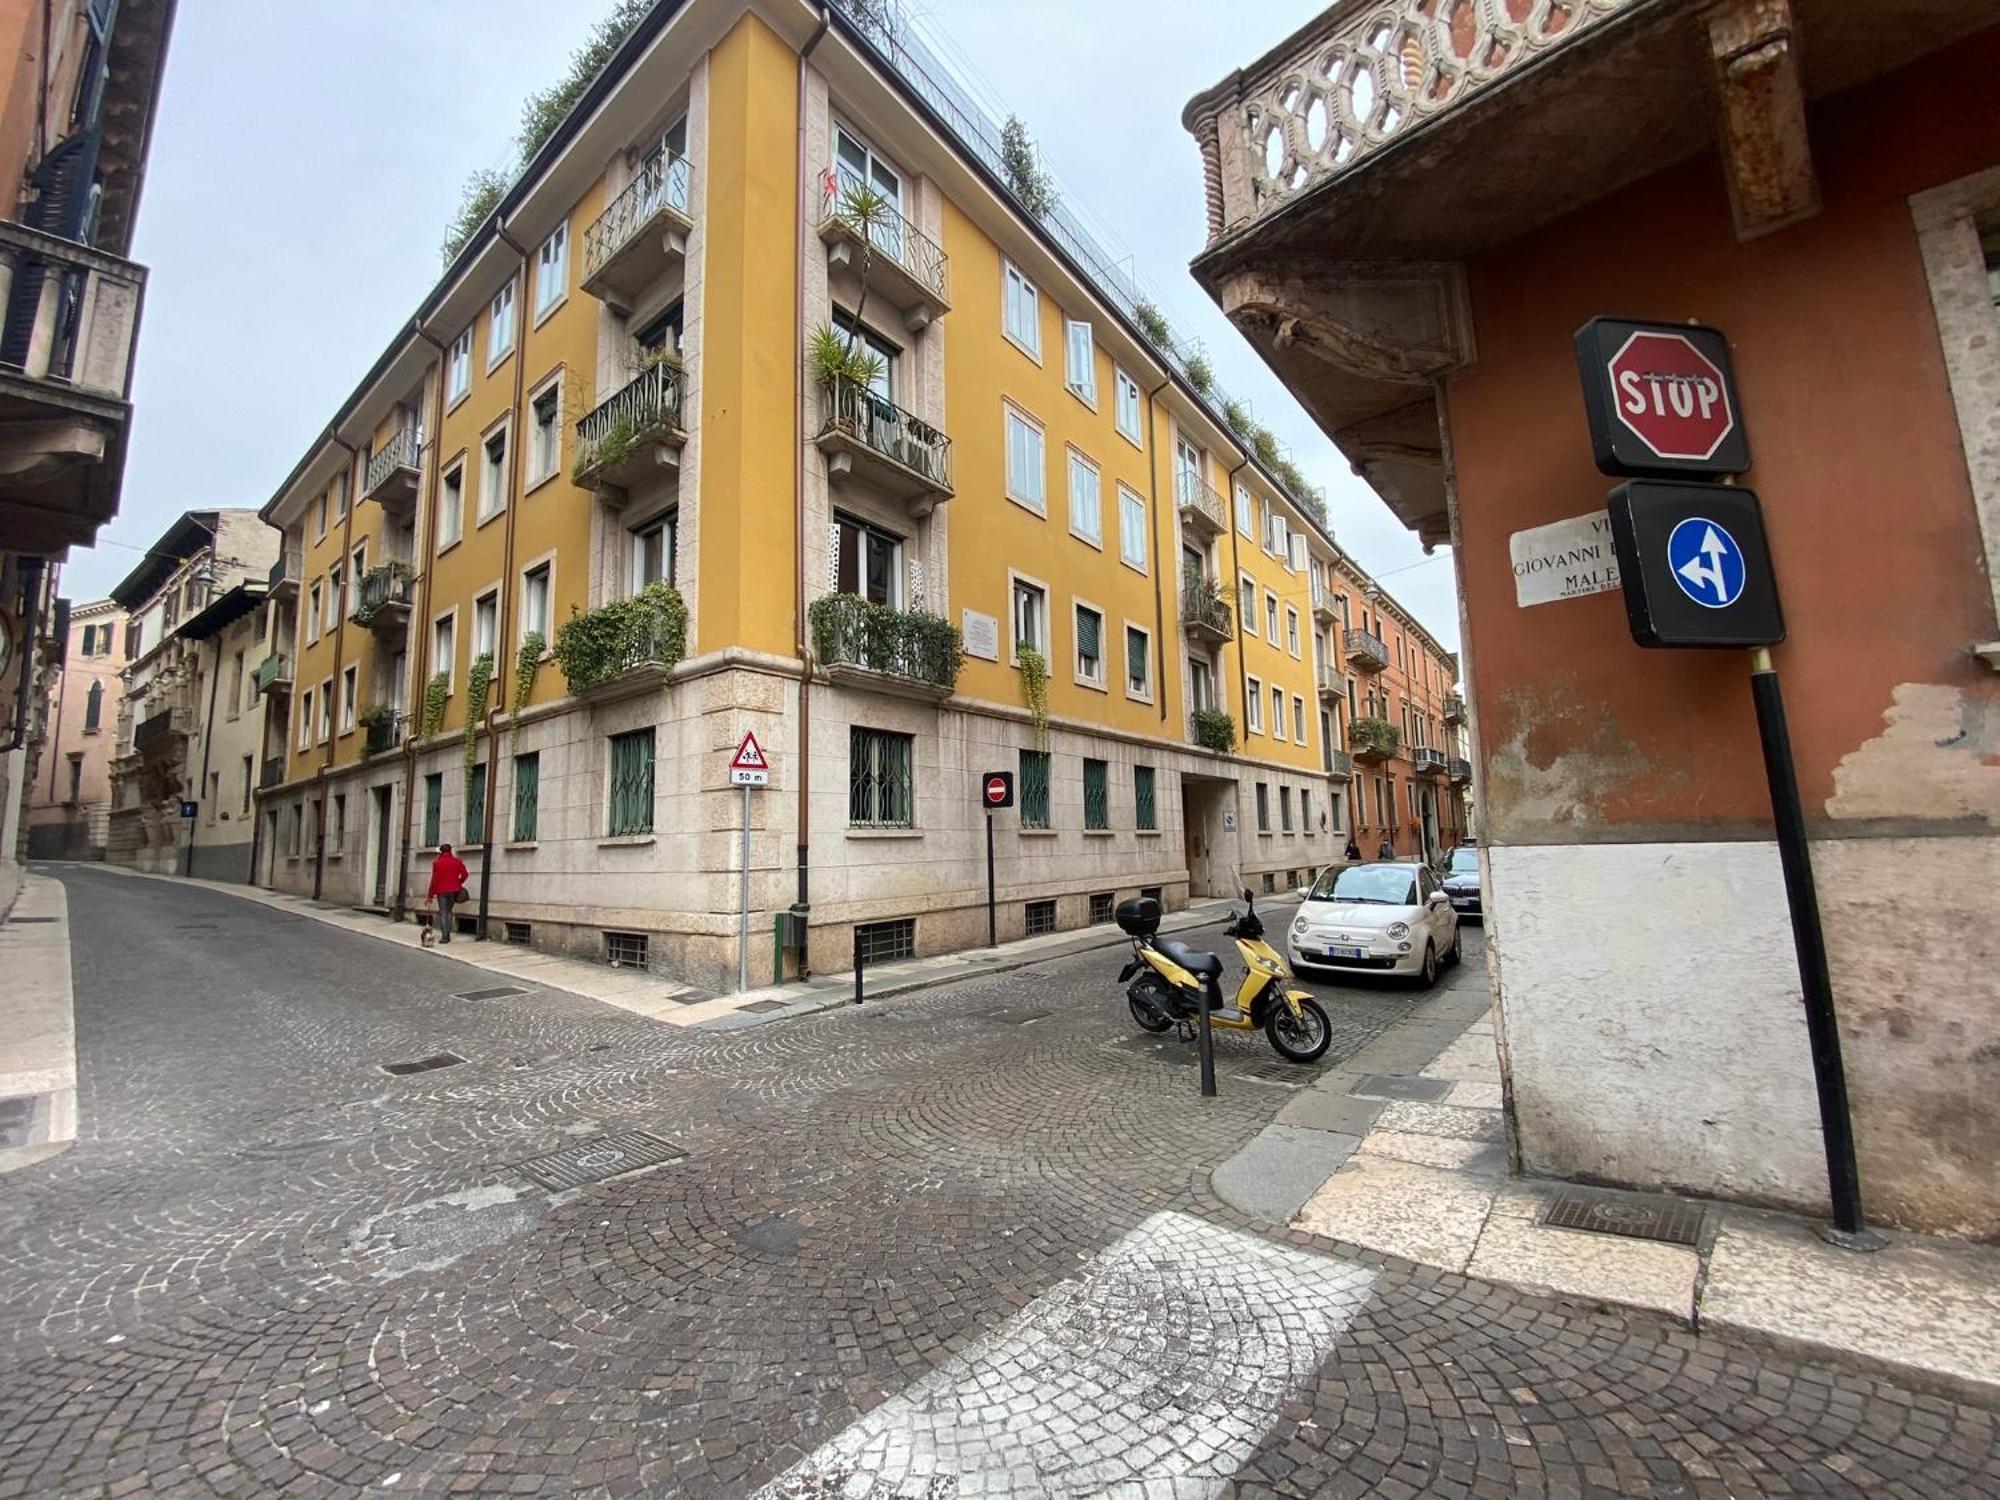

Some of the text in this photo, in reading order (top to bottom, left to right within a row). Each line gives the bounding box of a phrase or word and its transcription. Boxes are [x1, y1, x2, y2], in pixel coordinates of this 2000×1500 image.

[1619, 370, 1719, 420] STOP
[1591, 517, 1610, 533] VI
[1514, 545, 1600, 576] GIOVANNI
[1565, 567, 1619, 590] MALE
[739, 772, 751, 781] 50
